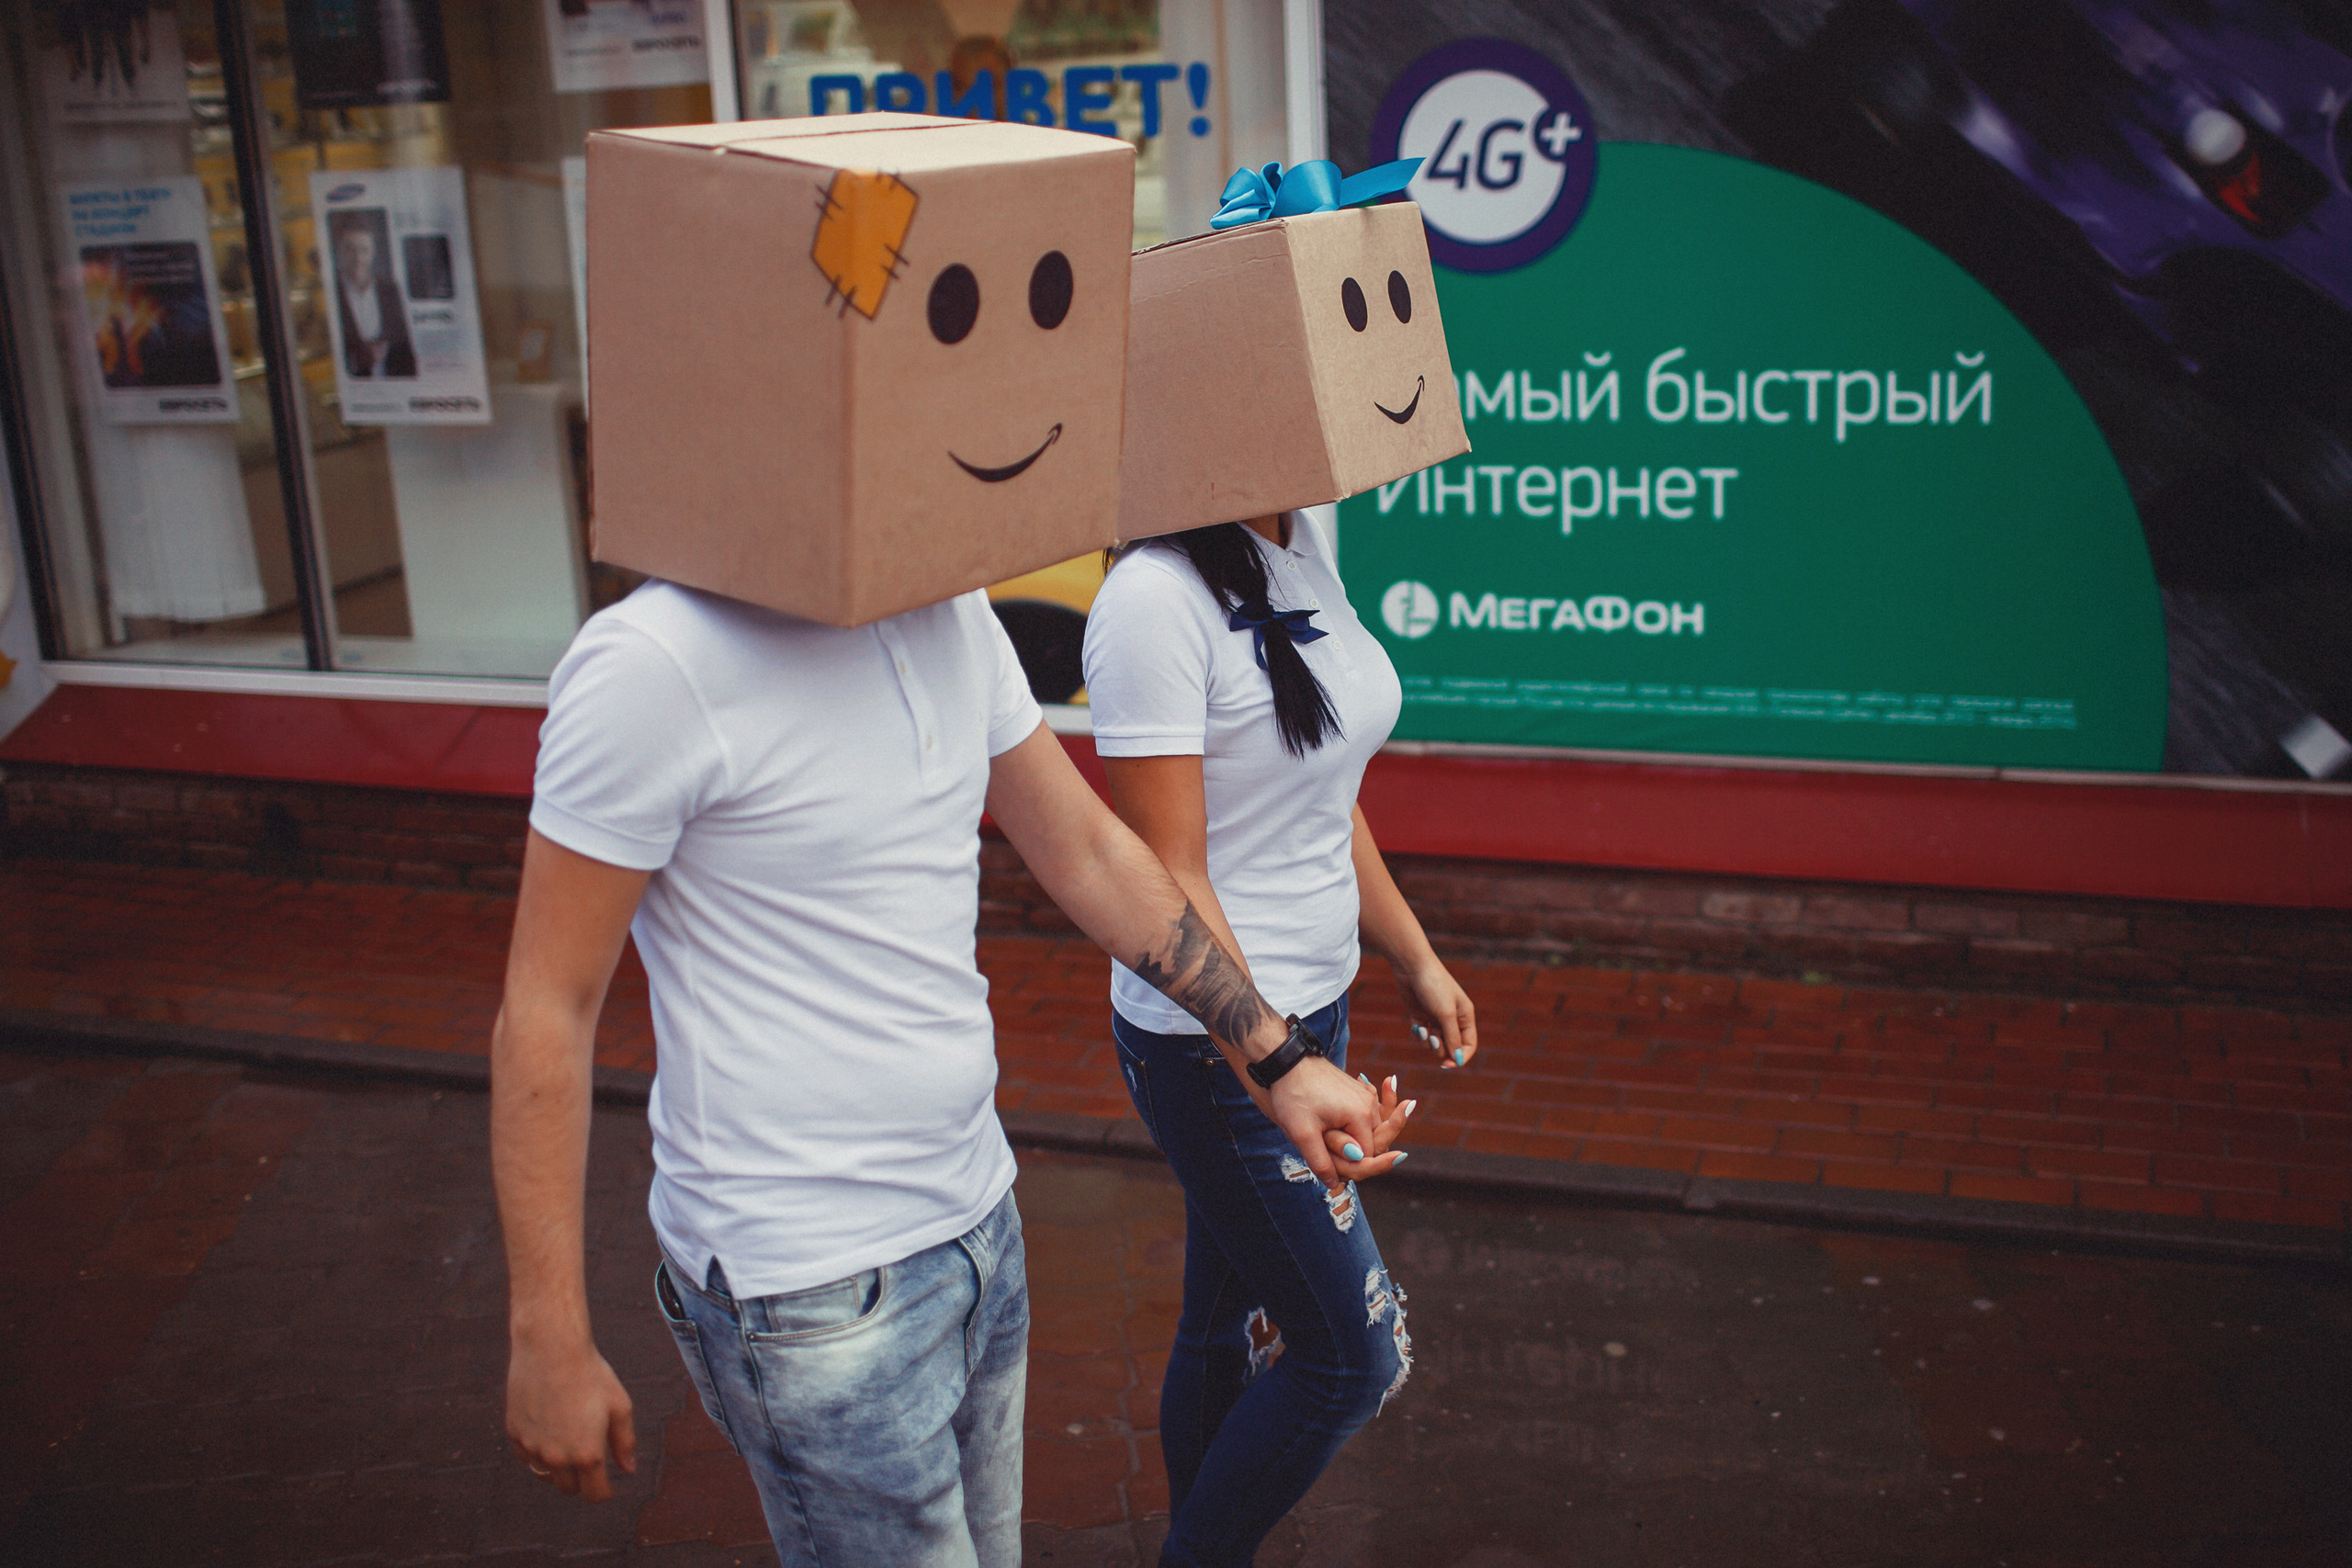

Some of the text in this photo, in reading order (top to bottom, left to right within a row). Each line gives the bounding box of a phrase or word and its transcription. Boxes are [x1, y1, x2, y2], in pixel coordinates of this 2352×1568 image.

[810, 62, 1211, 138] ПРИВЕТ!
[1453, 346, 1993, 444] мый быстрый
[1378, 465, 1739, 536] Интернет
